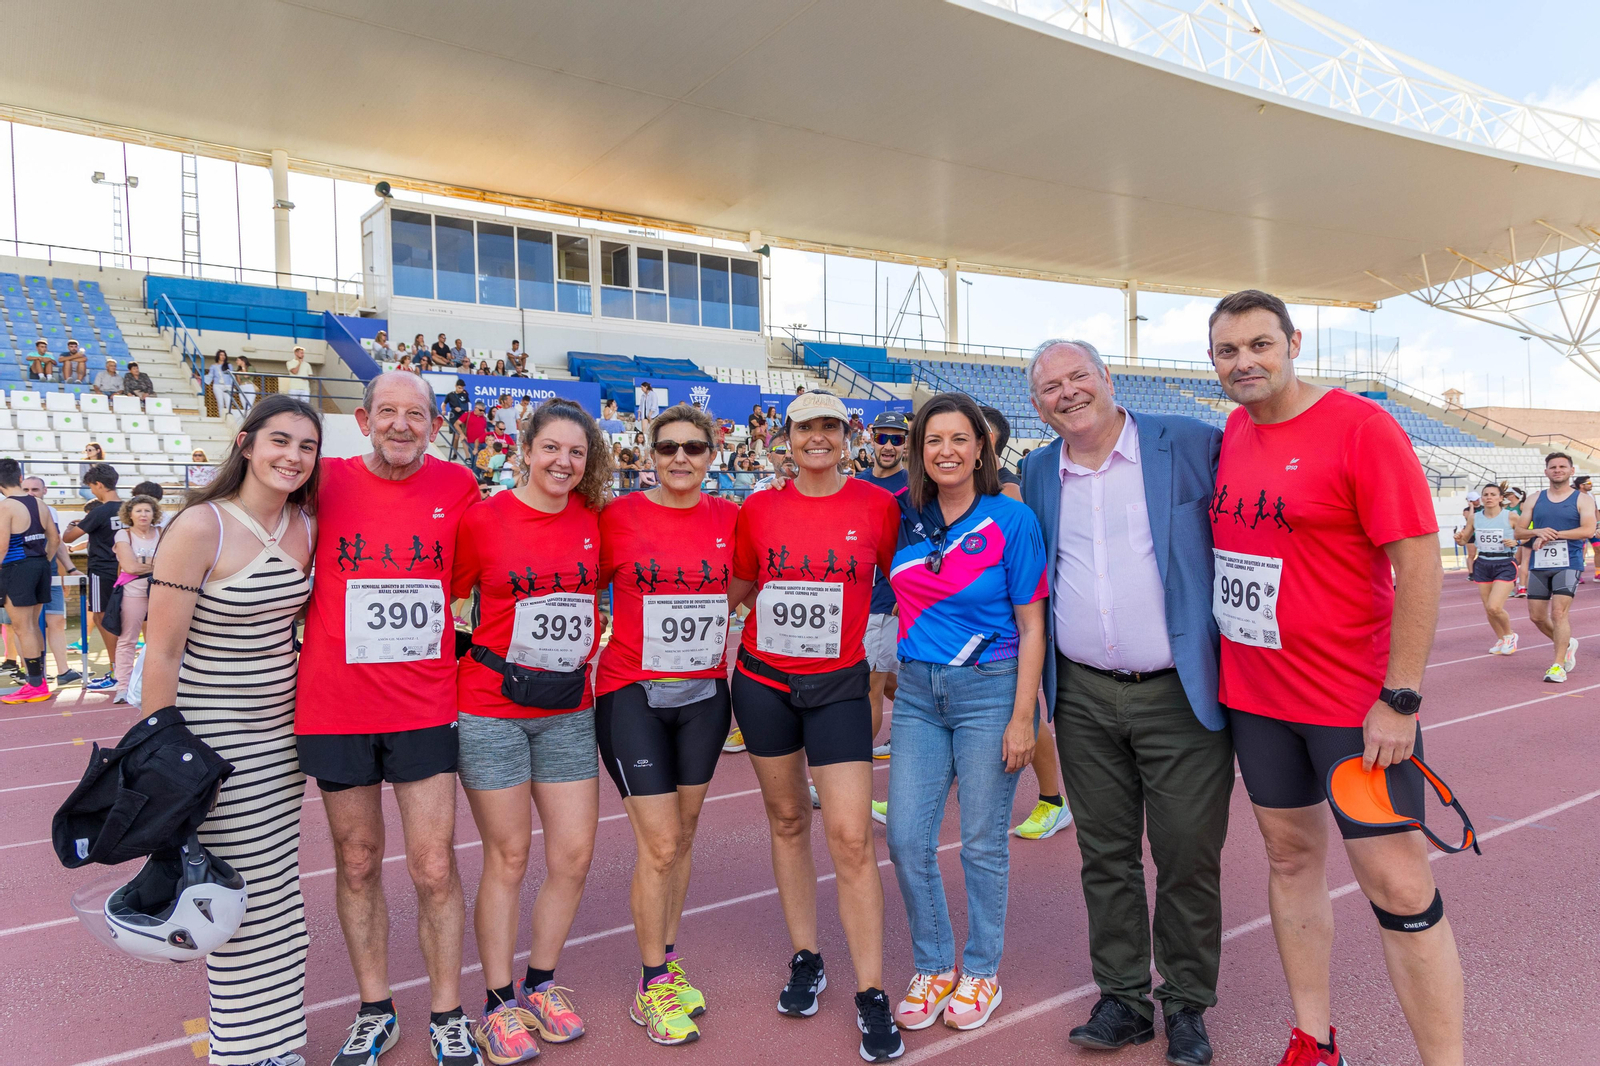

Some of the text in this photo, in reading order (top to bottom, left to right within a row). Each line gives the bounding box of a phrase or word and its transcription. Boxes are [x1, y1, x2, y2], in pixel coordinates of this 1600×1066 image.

[474, 386, 556, 399] SAN FERNANDO
[1480, 535, 1498, 543] 655
[1543, 548, 1558, 557] 79
[1222, 576, 1261, 611] 996
[367, 602, 428, 630] 390
[532, 614, 582, 641] 393
[773, 602, 825, 629] 998
[662, 617, 713, 642] 997
